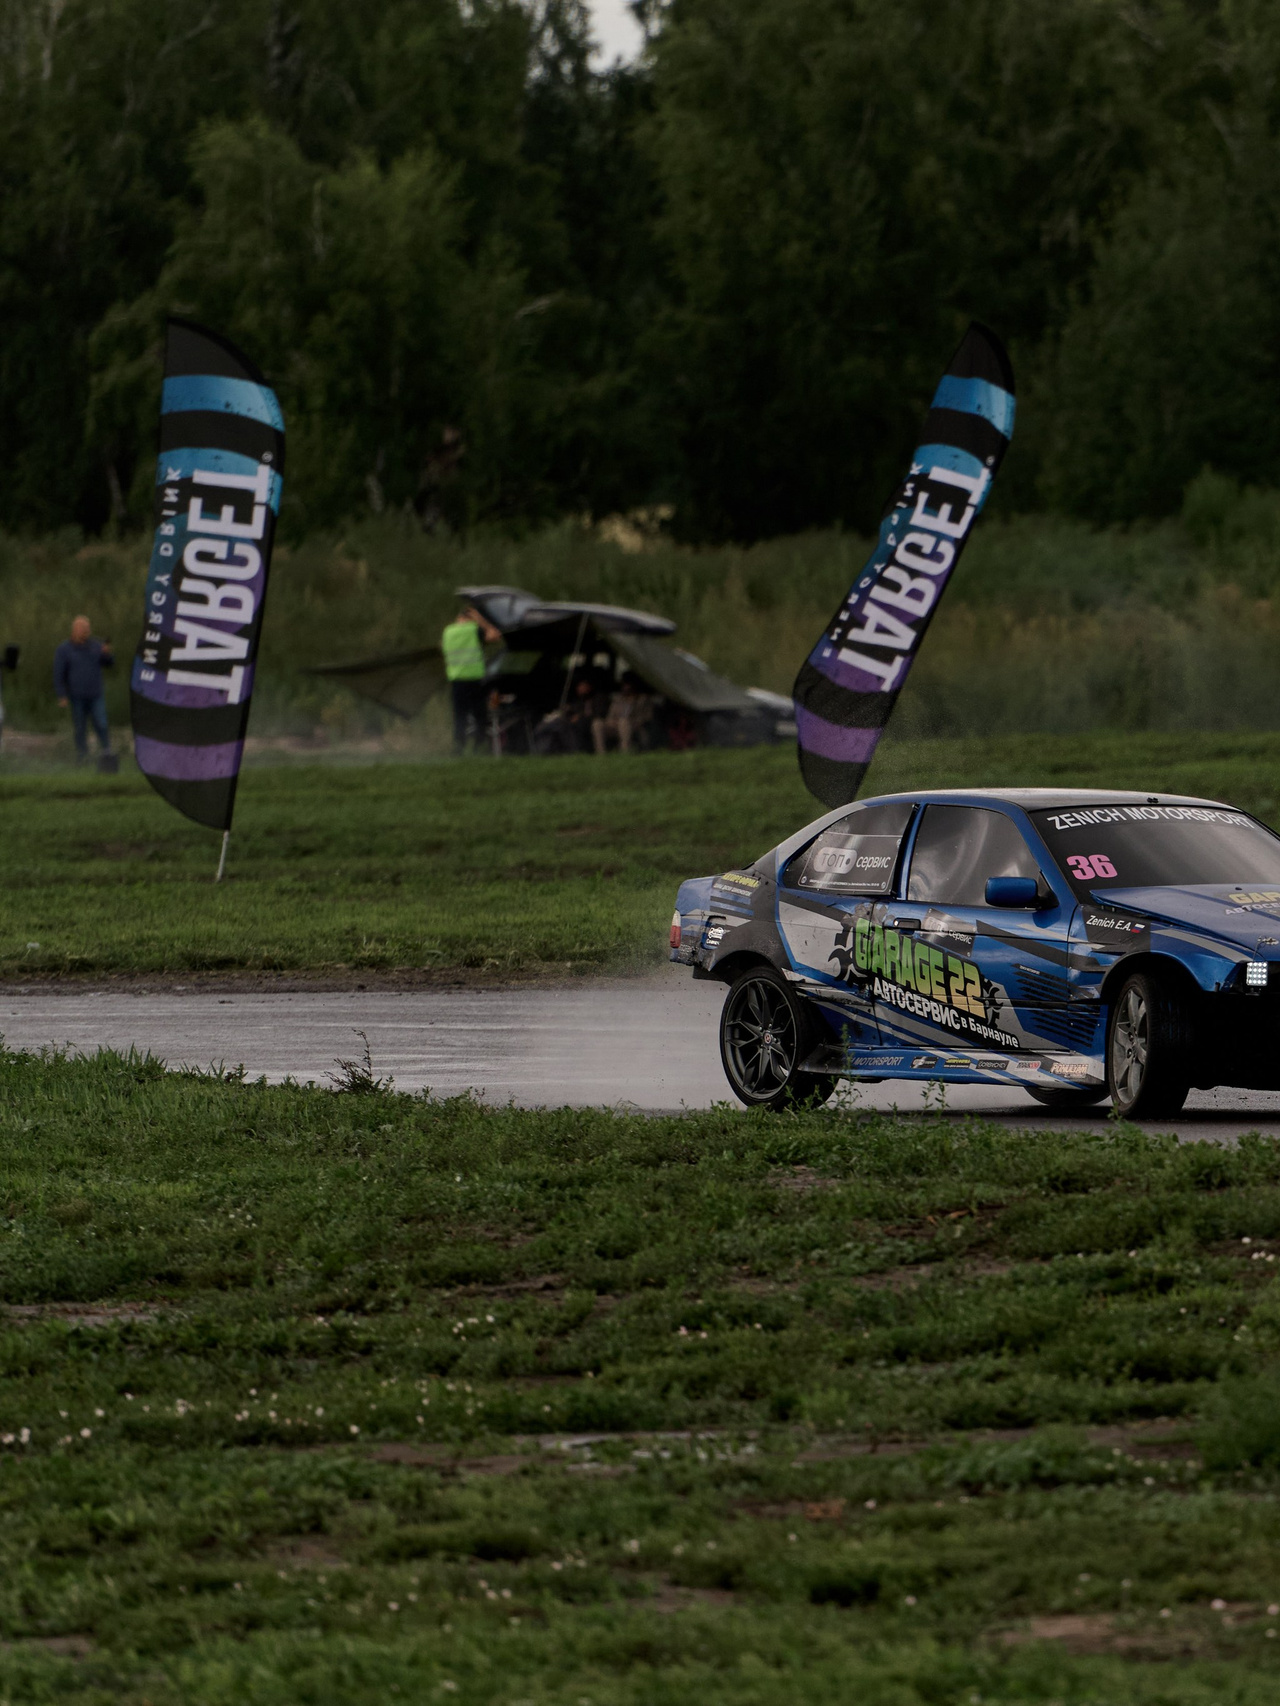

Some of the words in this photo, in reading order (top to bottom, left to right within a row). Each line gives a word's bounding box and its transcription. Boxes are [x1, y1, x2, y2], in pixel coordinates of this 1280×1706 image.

[1046, 807, 1127, 831] ZENICH
[1122, 806, 1254, 829] MOTORSPORT
[855, 856, 891, 871] сервис
[1066, 854, 1118, 880] 36
[1086, 914, 1115, 929] Zenich
[1114, 920, 1131, 931] E.A.
[854, 918, 949, 1005] GARAGE
[947, 955, 986, 1019] 22
[873, 977, 962, 1030] АВТОСЕРВИС
[968, 1016, 1019, 1048] Барнауле
[854, 1057, 904, 1066] MOTORSPORT
